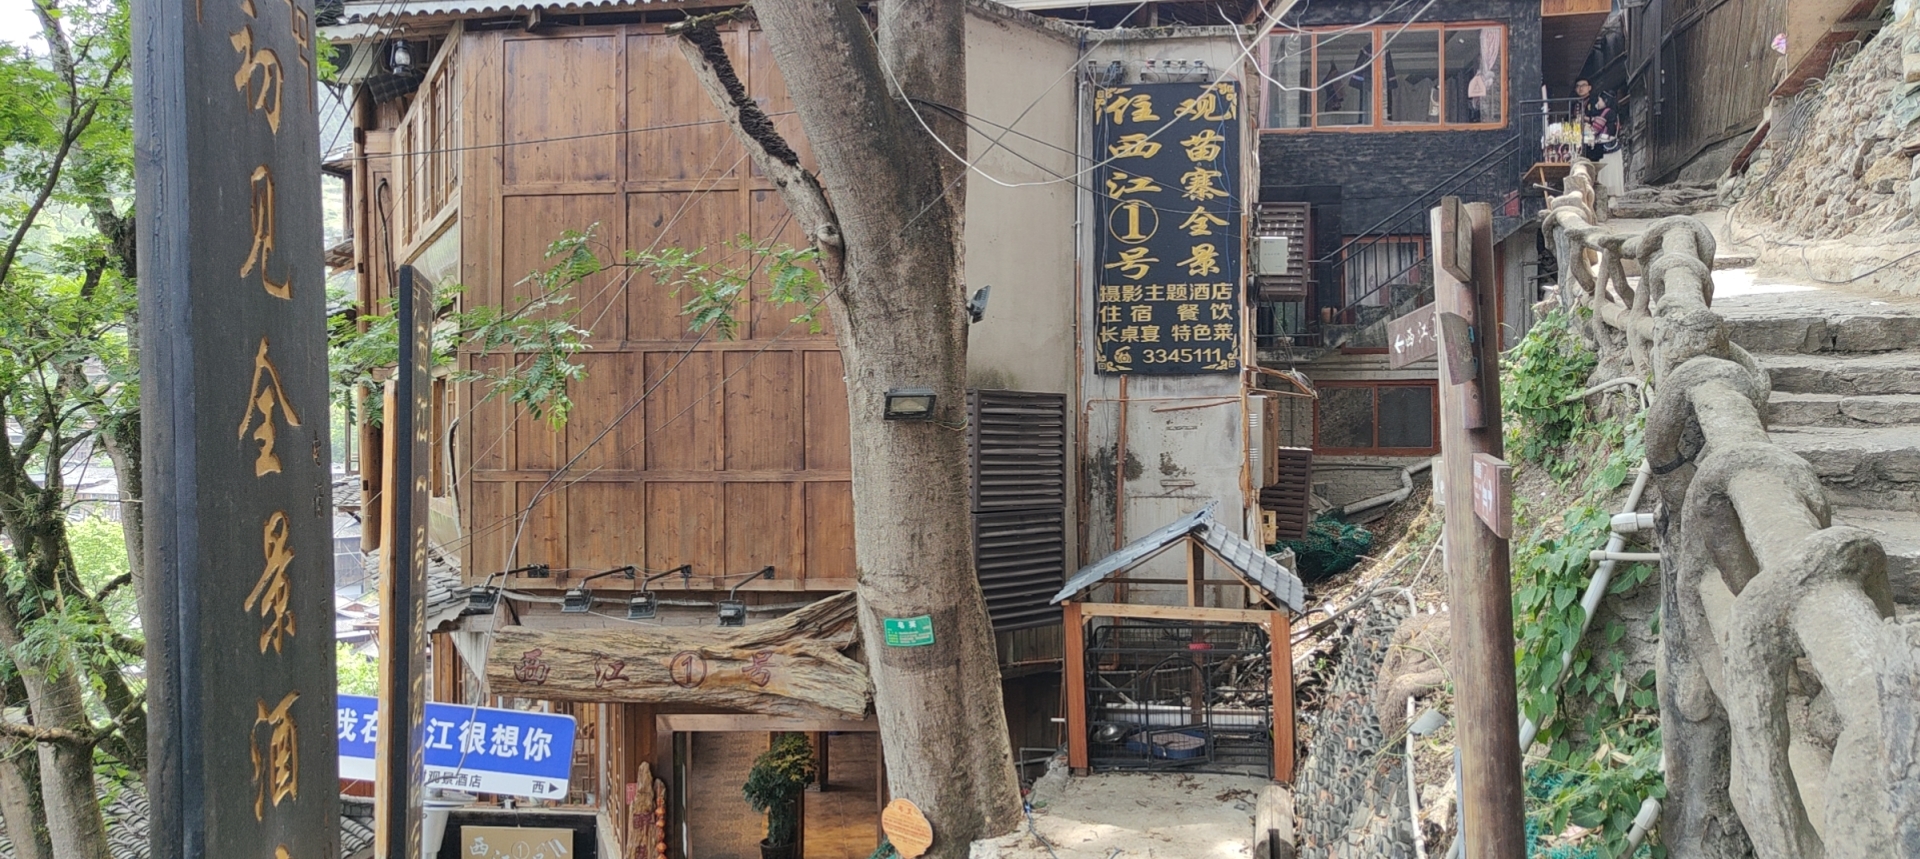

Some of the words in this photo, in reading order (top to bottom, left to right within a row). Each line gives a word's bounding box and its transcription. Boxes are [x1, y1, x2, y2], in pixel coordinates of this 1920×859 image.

[1173, 92, 1232, 278] 观苗寨全景
[1099, 283, 1234, 303] 摄影主题酒店
[1100, 304, 1153, 323] 住宿
[1176, 302, 1234, 322] 餐饮
[1100, 325, 1161, 344] 长桌宴
[1171, 323, 1234, 343] 特色菜
[1143, 347, 1222, 364] 3345111
[229, 0, 302, 859] 初见全景酒
[337, 706, 553, 763] 我在江很想你
[421, 768, 483, 789] 观景酒店
[531, 779, 546, 794] 西
